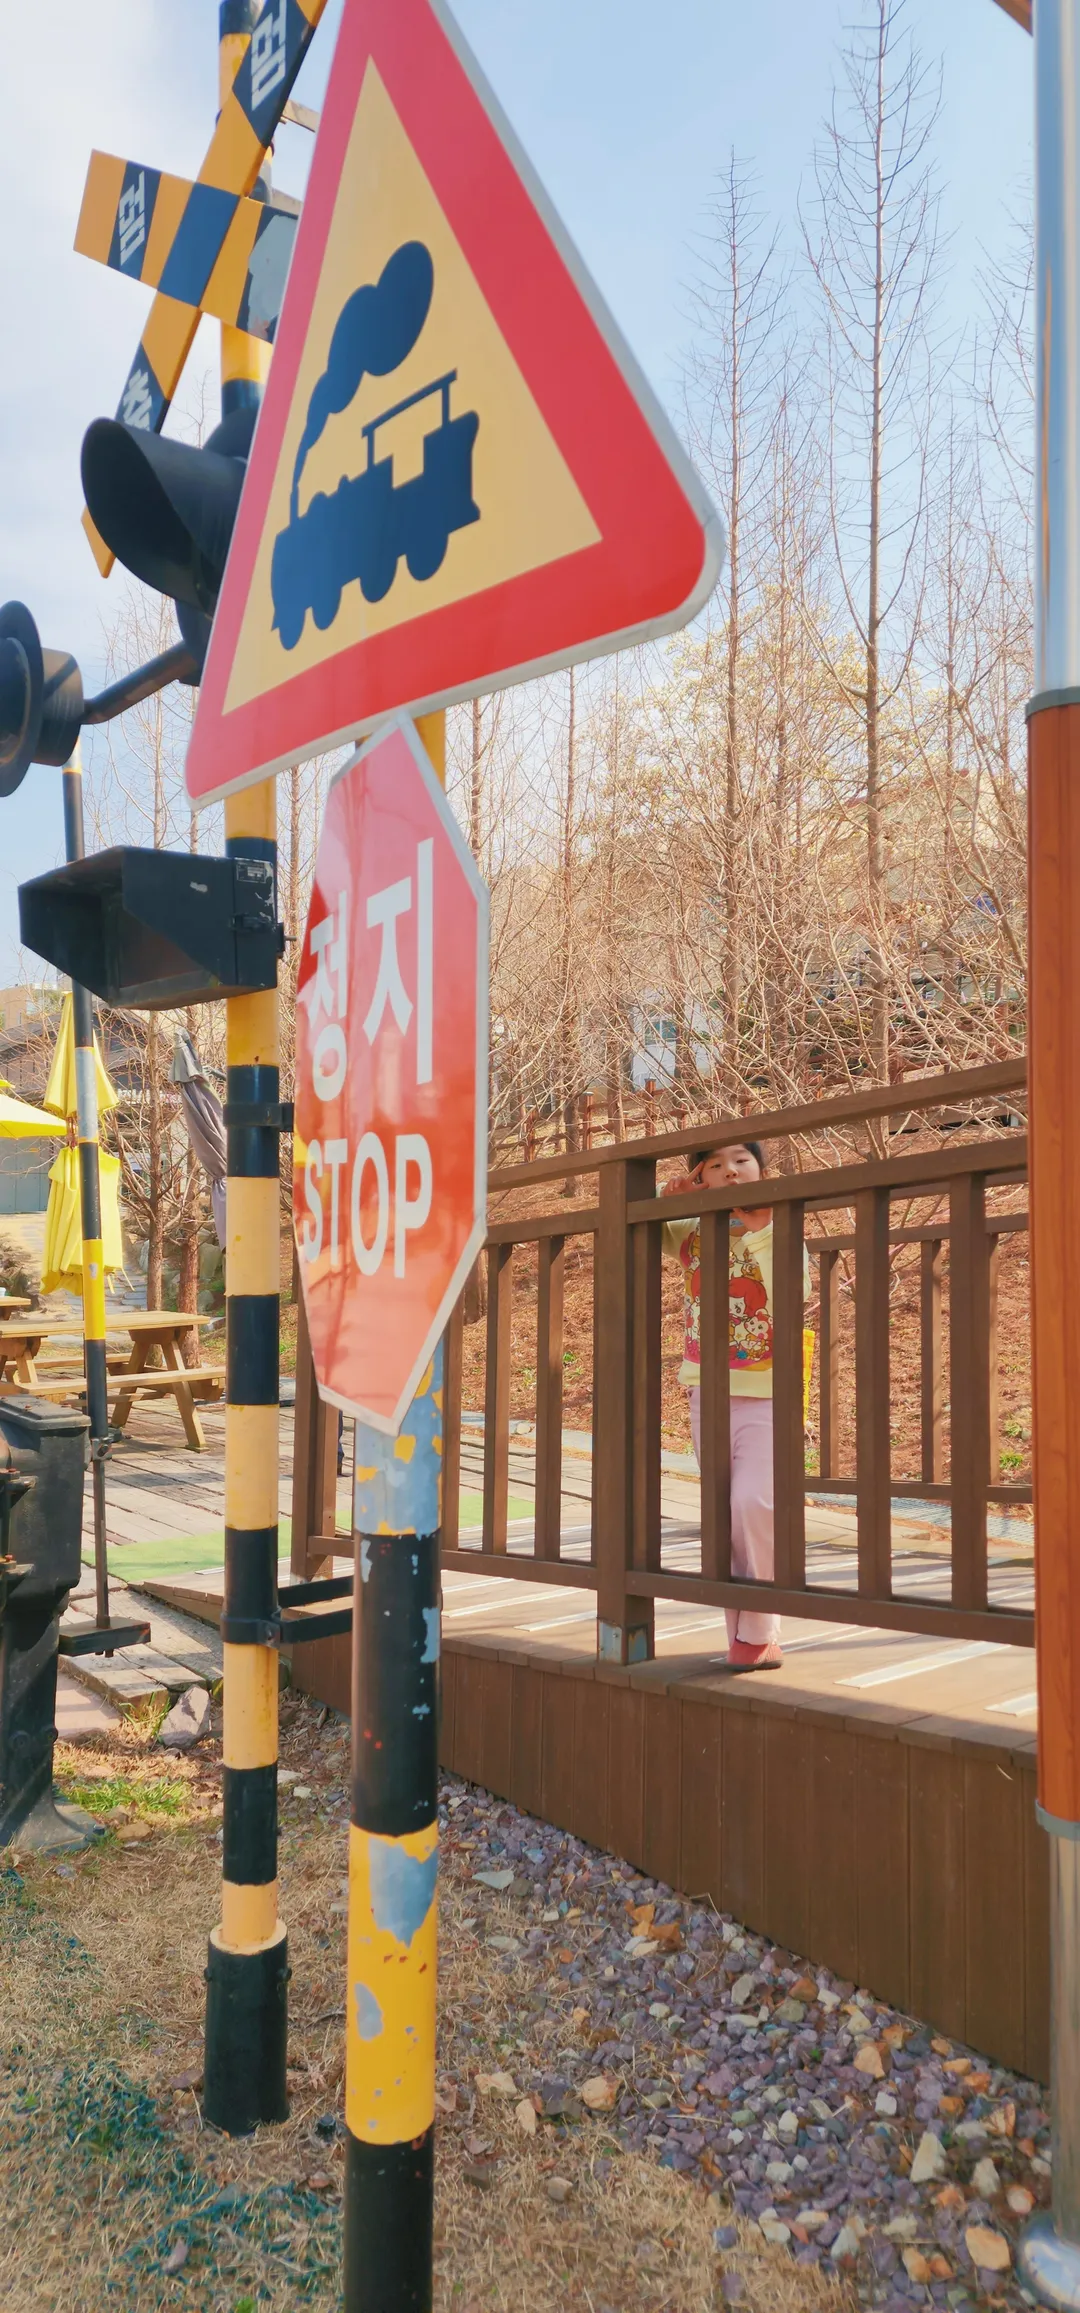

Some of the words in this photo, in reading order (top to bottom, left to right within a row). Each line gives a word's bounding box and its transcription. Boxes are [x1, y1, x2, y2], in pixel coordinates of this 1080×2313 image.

[119, 170, 145, 266] 멈
[307, 837, 434, 1102] 정지
[302, 1131, 433, 1279] STOP
